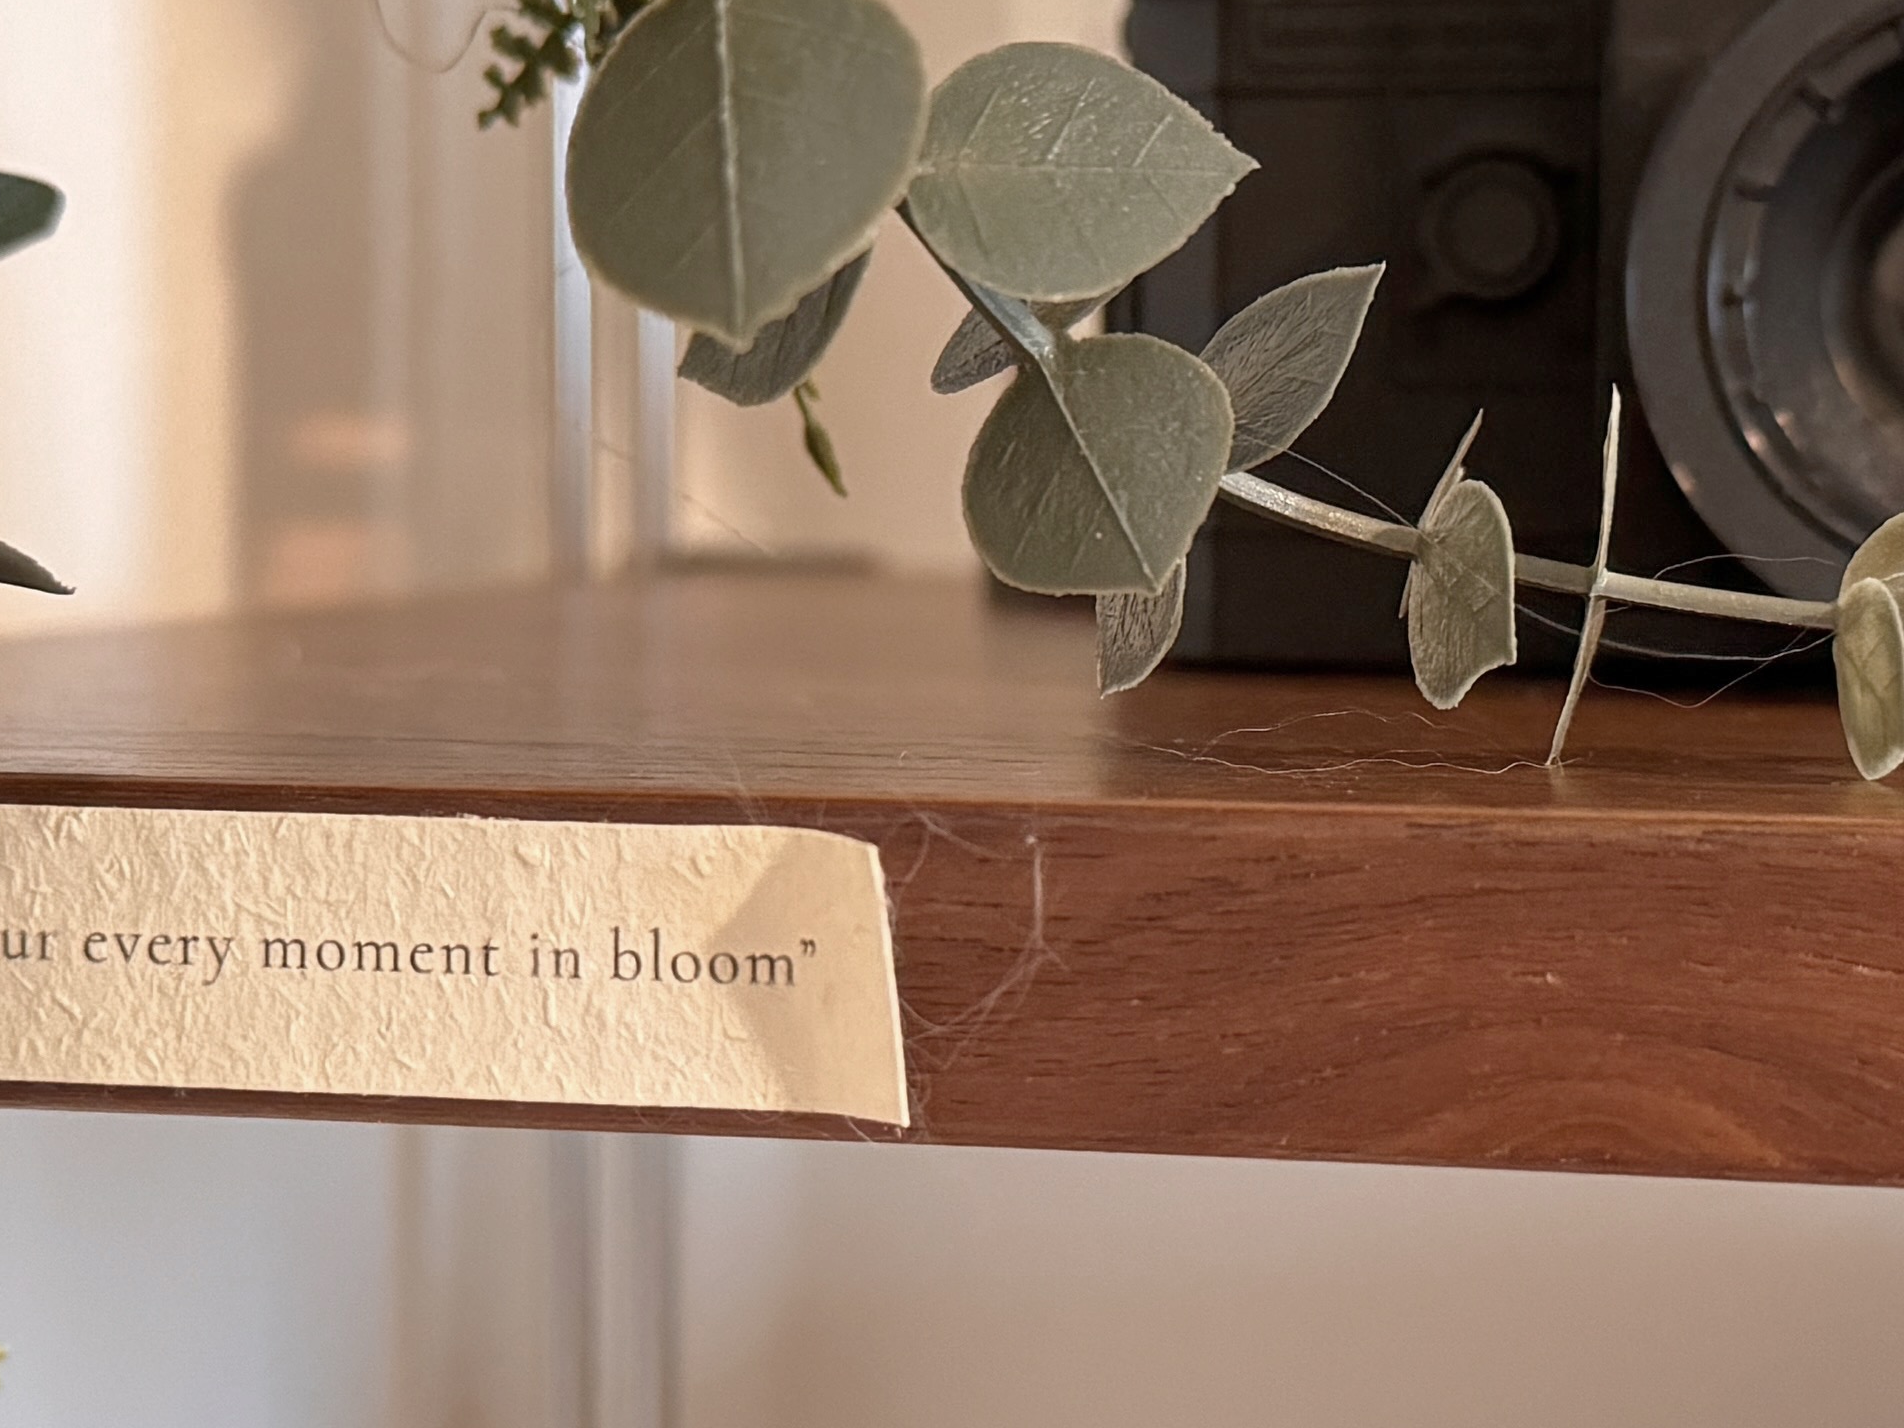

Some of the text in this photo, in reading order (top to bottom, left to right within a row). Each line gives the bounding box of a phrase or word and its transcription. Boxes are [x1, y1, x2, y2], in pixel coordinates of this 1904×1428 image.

[81, 928, 234, 986] every
[260, 933, 500, 980] moment
[529, 934, 582, 980] in
[608, 927, 820, 988] bloom”
